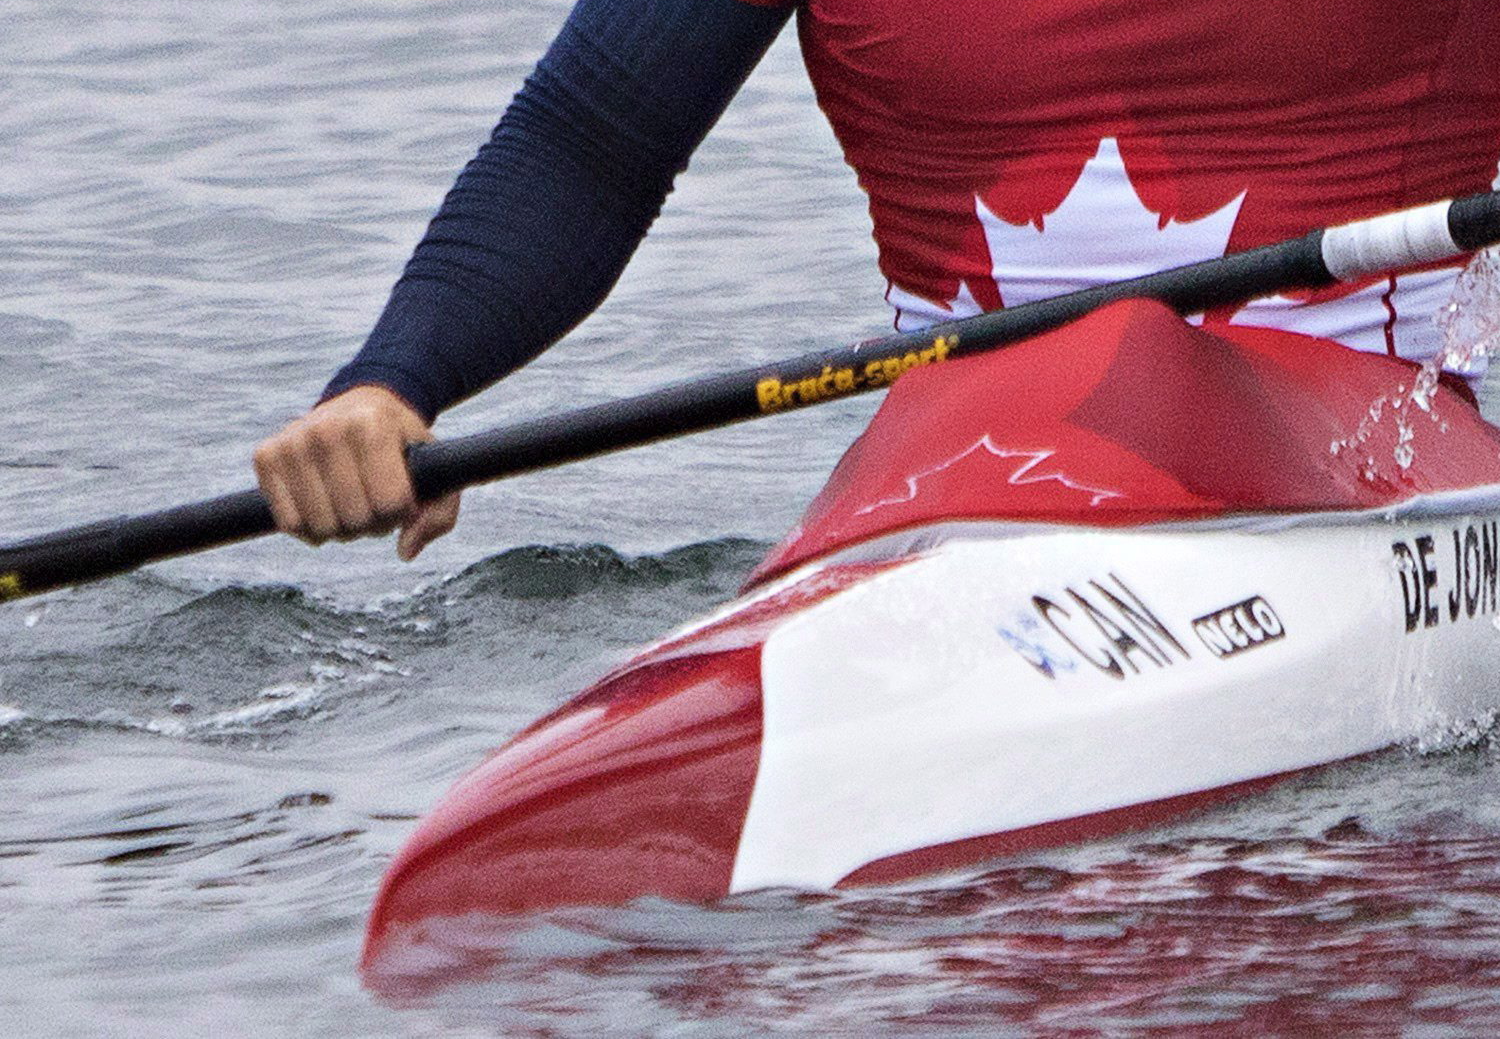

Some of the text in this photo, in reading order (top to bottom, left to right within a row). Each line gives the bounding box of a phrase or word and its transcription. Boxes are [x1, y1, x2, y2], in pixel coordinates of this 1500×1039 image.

[1031, 572, 1191, 680] CAN
[1191, 595, 1286, 660] NELO
[1392, 535, 1440, 633] DE
